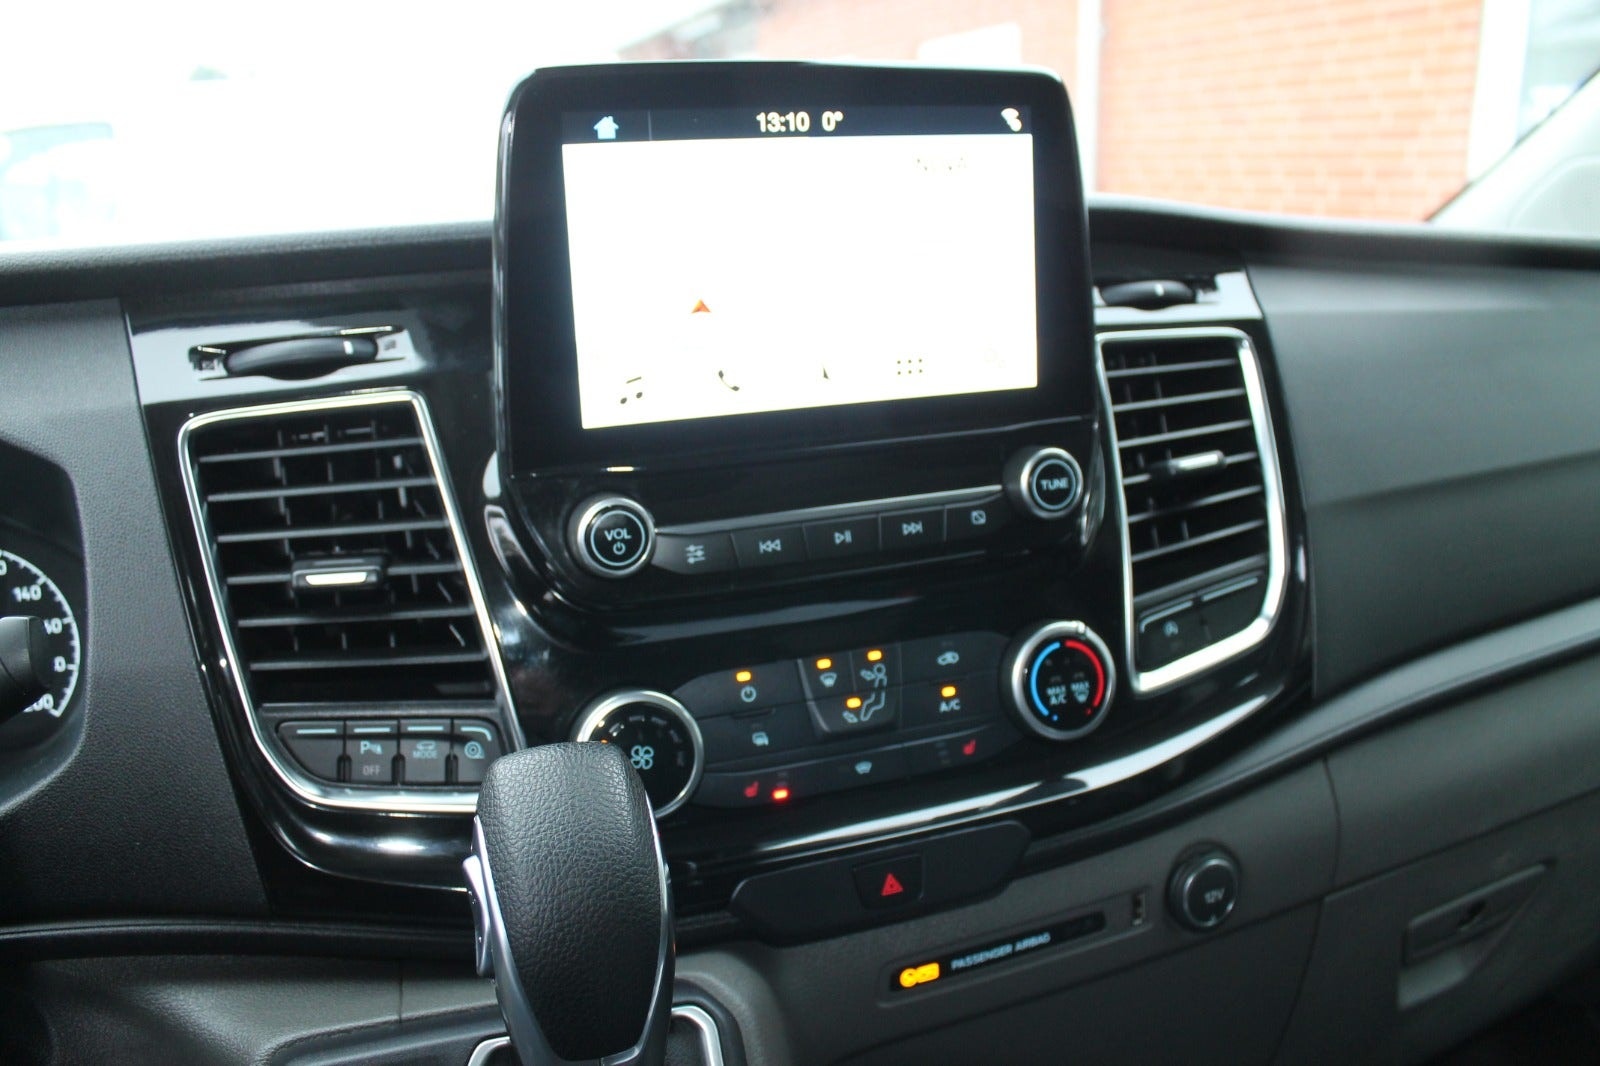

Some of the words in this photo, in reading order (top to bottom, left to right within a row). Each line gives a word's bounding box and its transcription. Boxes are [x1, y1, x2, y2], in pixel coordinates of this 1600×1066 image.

[756, 111, 811, 133] 13:10
[1040, 477, 1069, 491] TUNE
[604, 527, 632, 541] VOL
[12, 584, 42, 602] 140
[939, 698, 961, 713] A/C
[412, 749, 438, 759] MODE
[362, 765, 380, 776] OFF
[950, 943, 1014, 970] PASSENGER
[1014, 931, 1051, 951] AIRBAG
